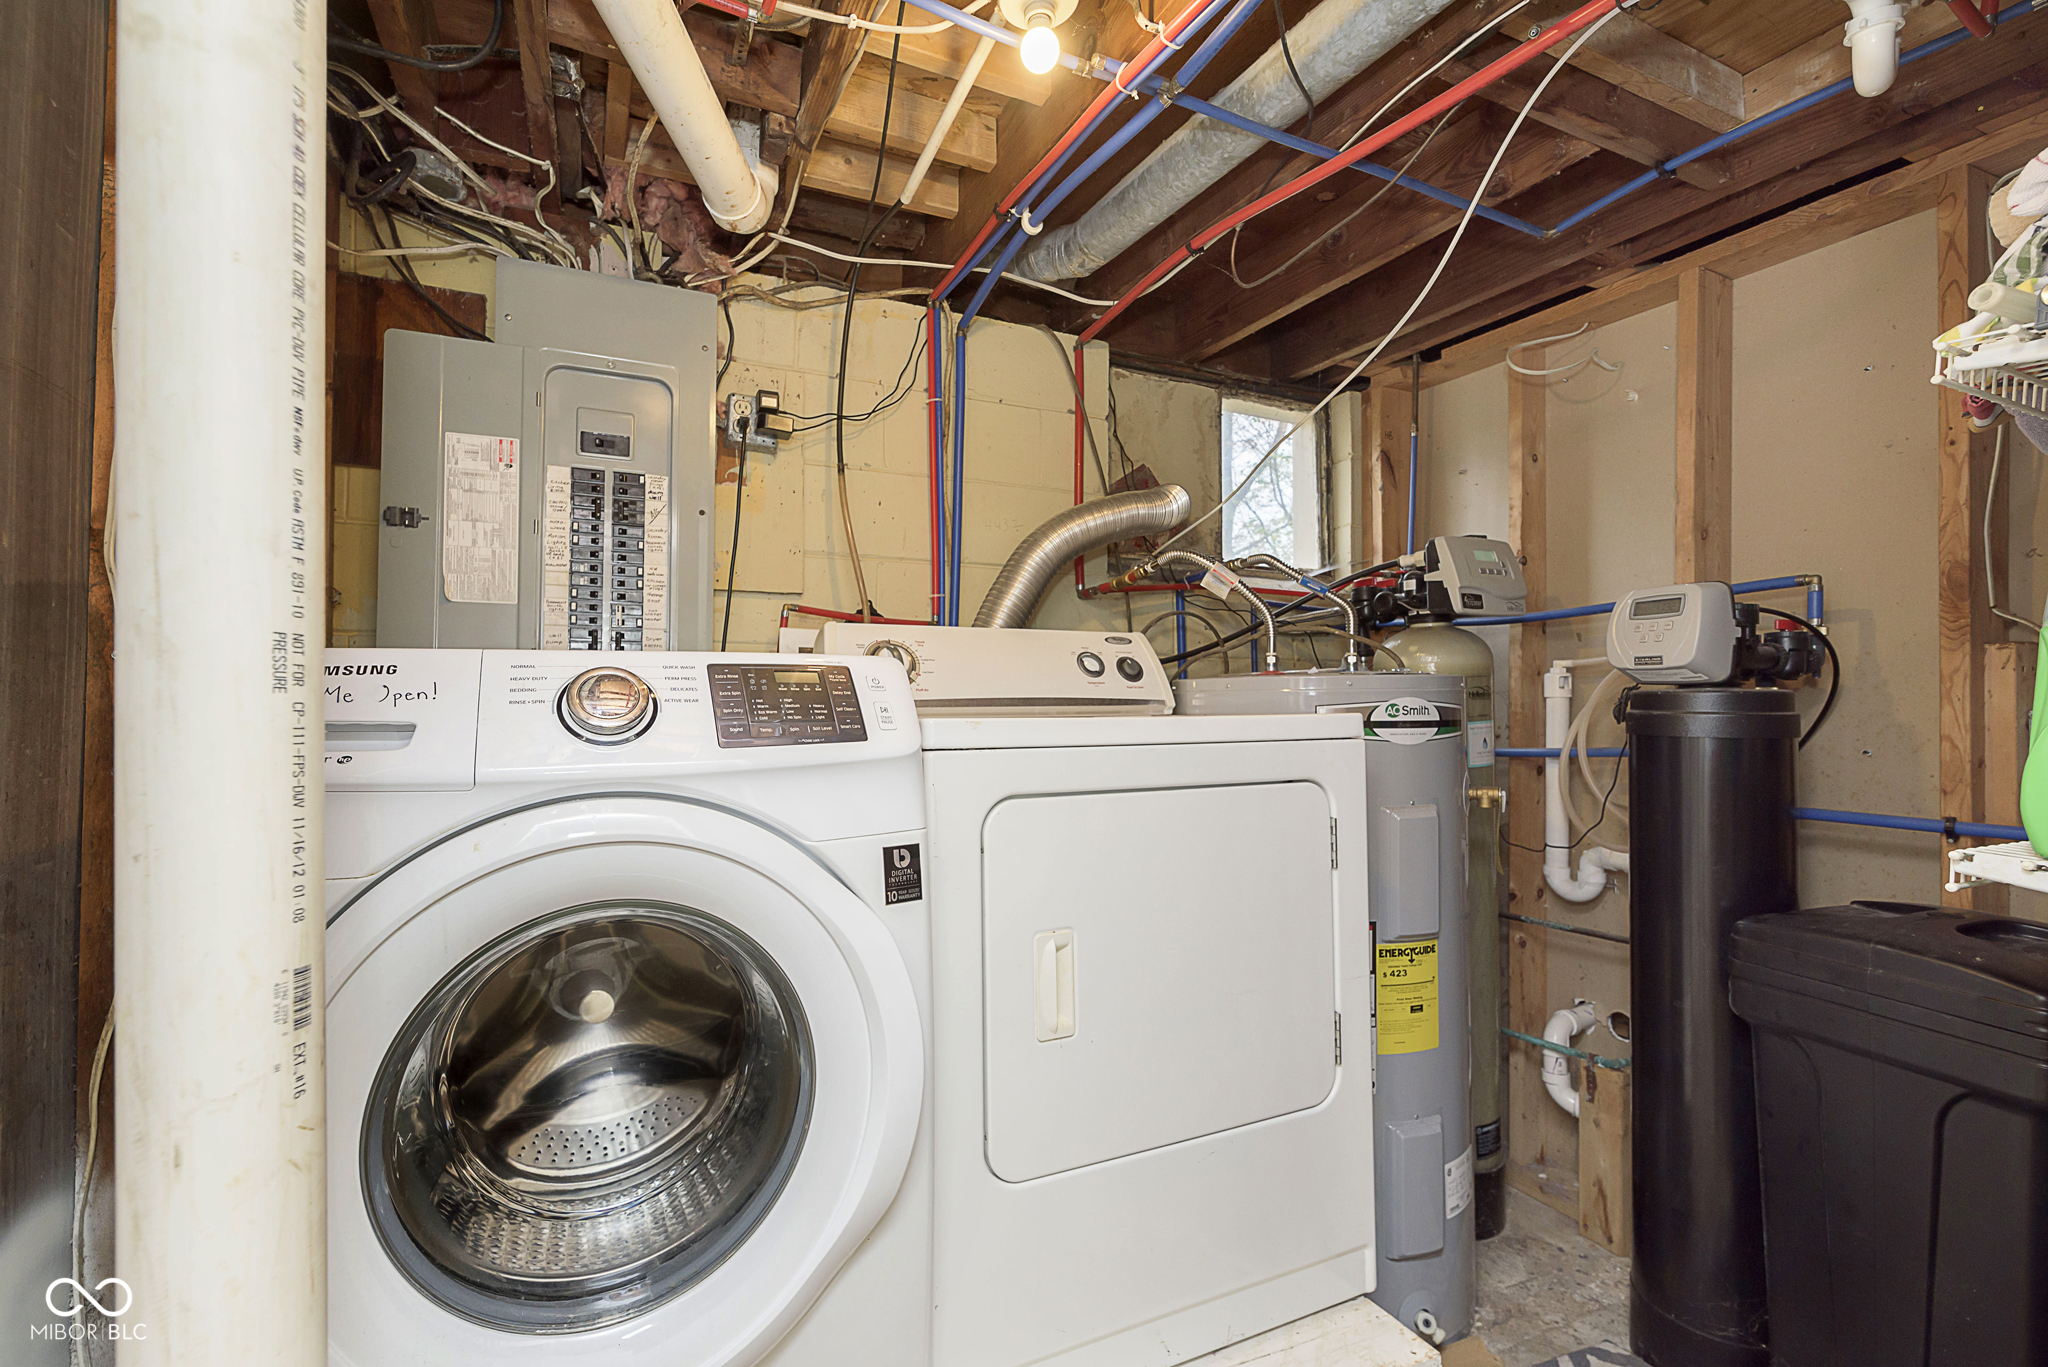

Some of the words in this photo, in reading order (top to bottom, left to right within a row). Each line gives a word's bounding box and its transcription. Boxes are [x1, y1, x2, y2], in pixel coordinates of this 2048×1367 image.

[292, 202, 306, 267] CELLULAR
[292, 269, 306, 304] CORE
[292, 305, 306, 364] PVC-DWV
[292, 365, 306, 400] PIPE
[291, 517, 305, 551] ASTM
[291, 556, 305, 566] F
[291, 571, 305, 619] 891-10
[291, 632, 305, 656] NOT
[272, 631, 288, 693] PRESSURE
[291, 663, 305, 687] FOR
[292, 701, 305, 808] CP-111-FPS-DWV
[292, 817, 305, 877] 11/16/12
[889, 874, 918, 883] INVERTER
[892, 868, 914, 877] DIGITAL
[887, 891, 898, 902] 10
[1390, 969, 1408, 977] 423
